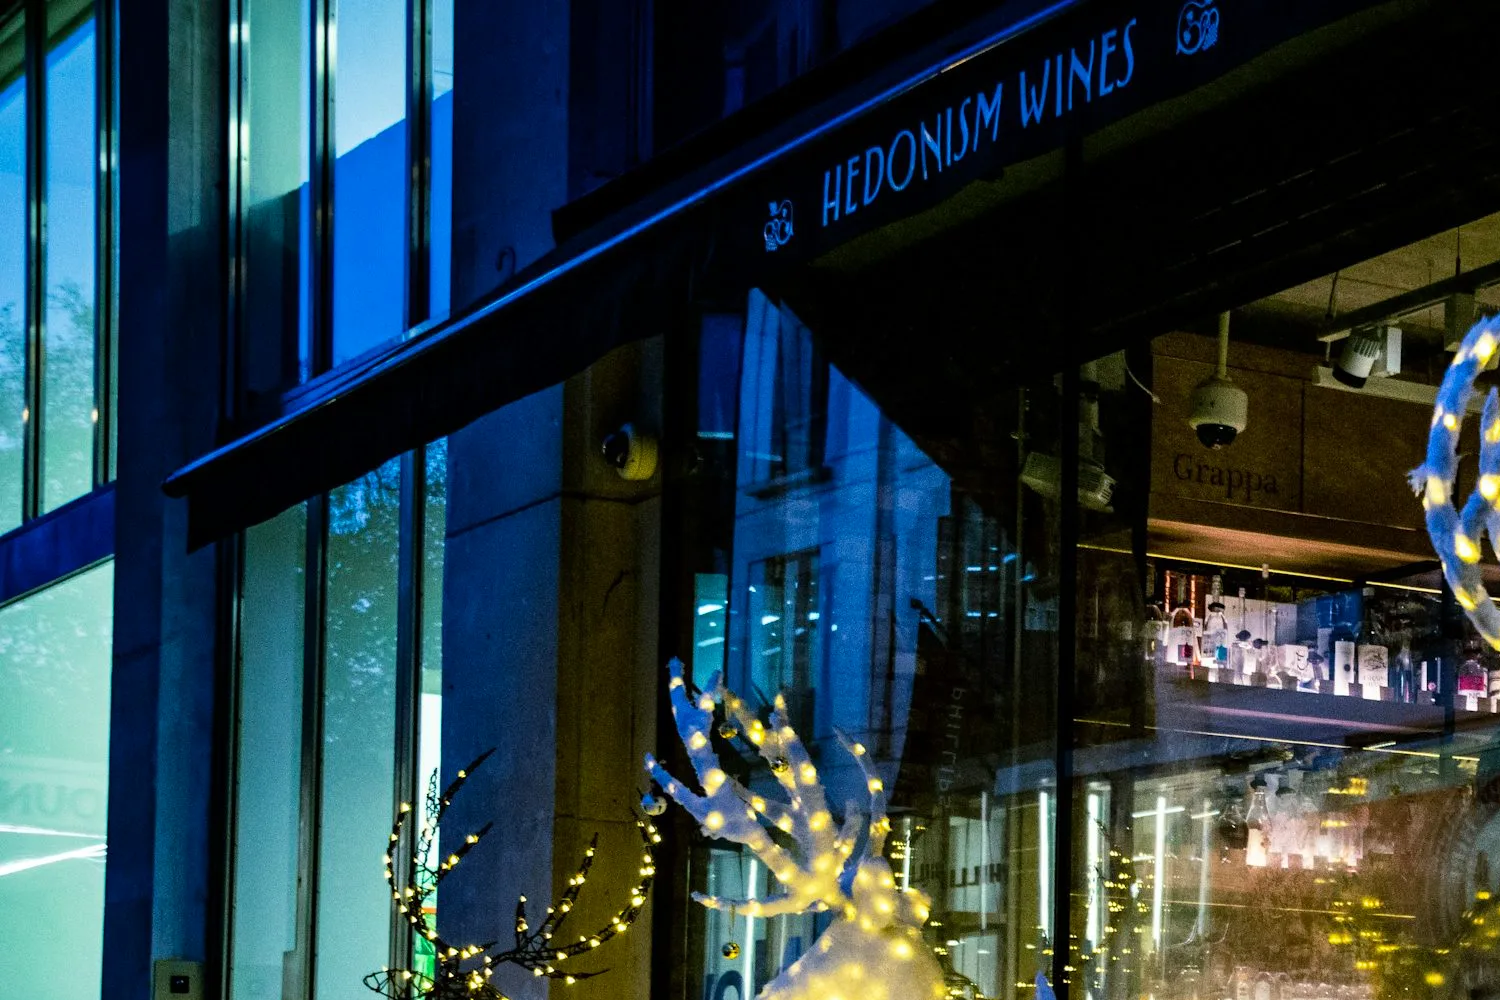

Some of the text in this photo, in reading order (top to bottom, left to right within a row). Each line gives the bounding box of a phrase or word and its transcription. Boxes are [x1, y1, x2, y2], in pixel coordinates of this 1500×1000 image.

[821, 18, 1137, 227] HEDONISM WINES
[1173, 453, 1279, 502] Grappa
